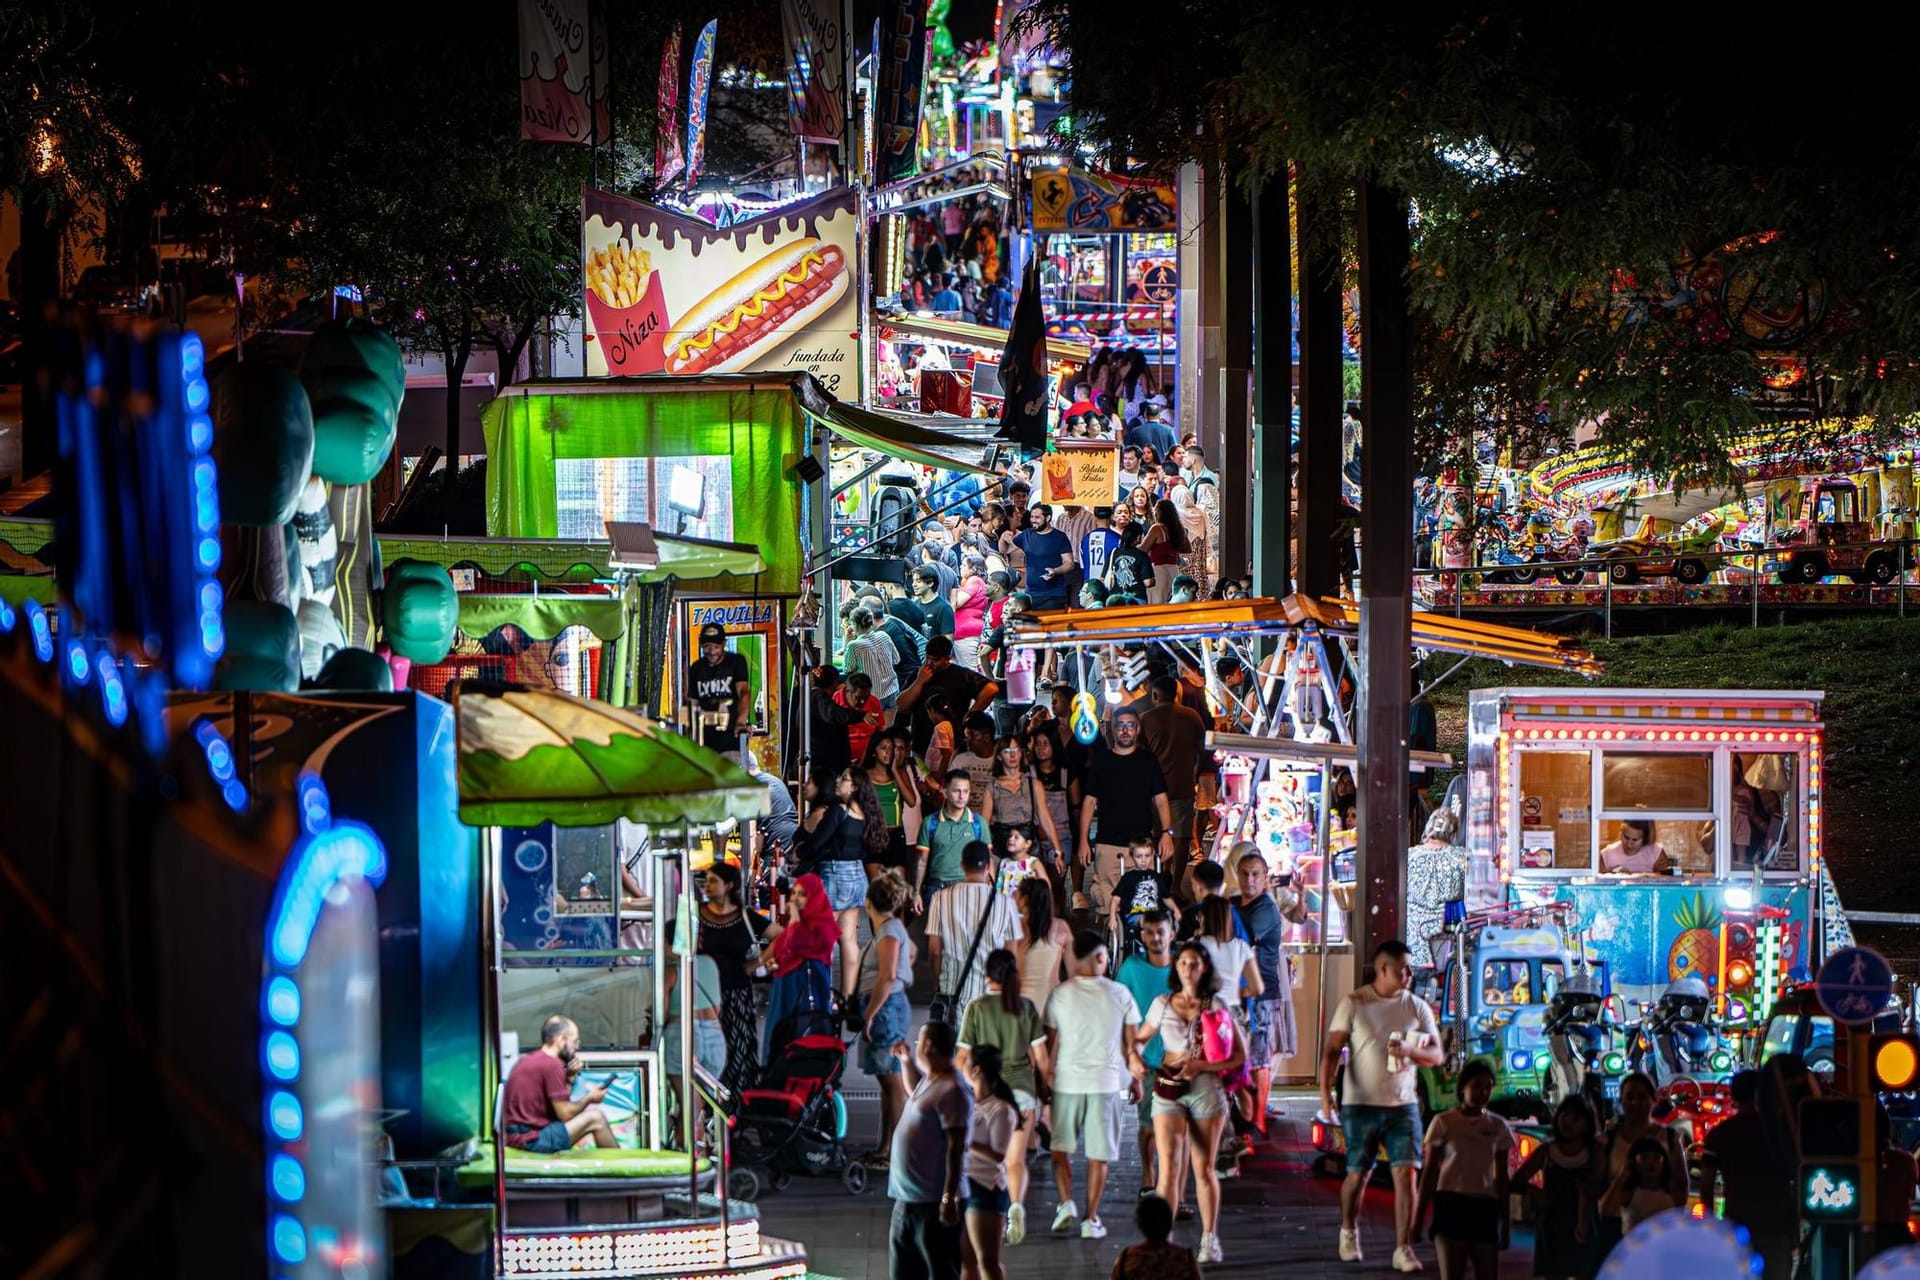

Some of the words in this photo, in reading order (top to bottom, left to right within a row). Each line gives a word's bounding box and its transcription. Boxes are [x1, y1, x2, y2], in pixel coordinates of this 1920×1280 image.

[611, 311, 660, 366] Niza
[783, 348, 845, 366] fundada
[807, 364, 820, 372] en
[1090, 547, 1104, 566] 12
[693, 605, 772, 625] TAQUILLA
[697, 676, 734, 697] LYNX
